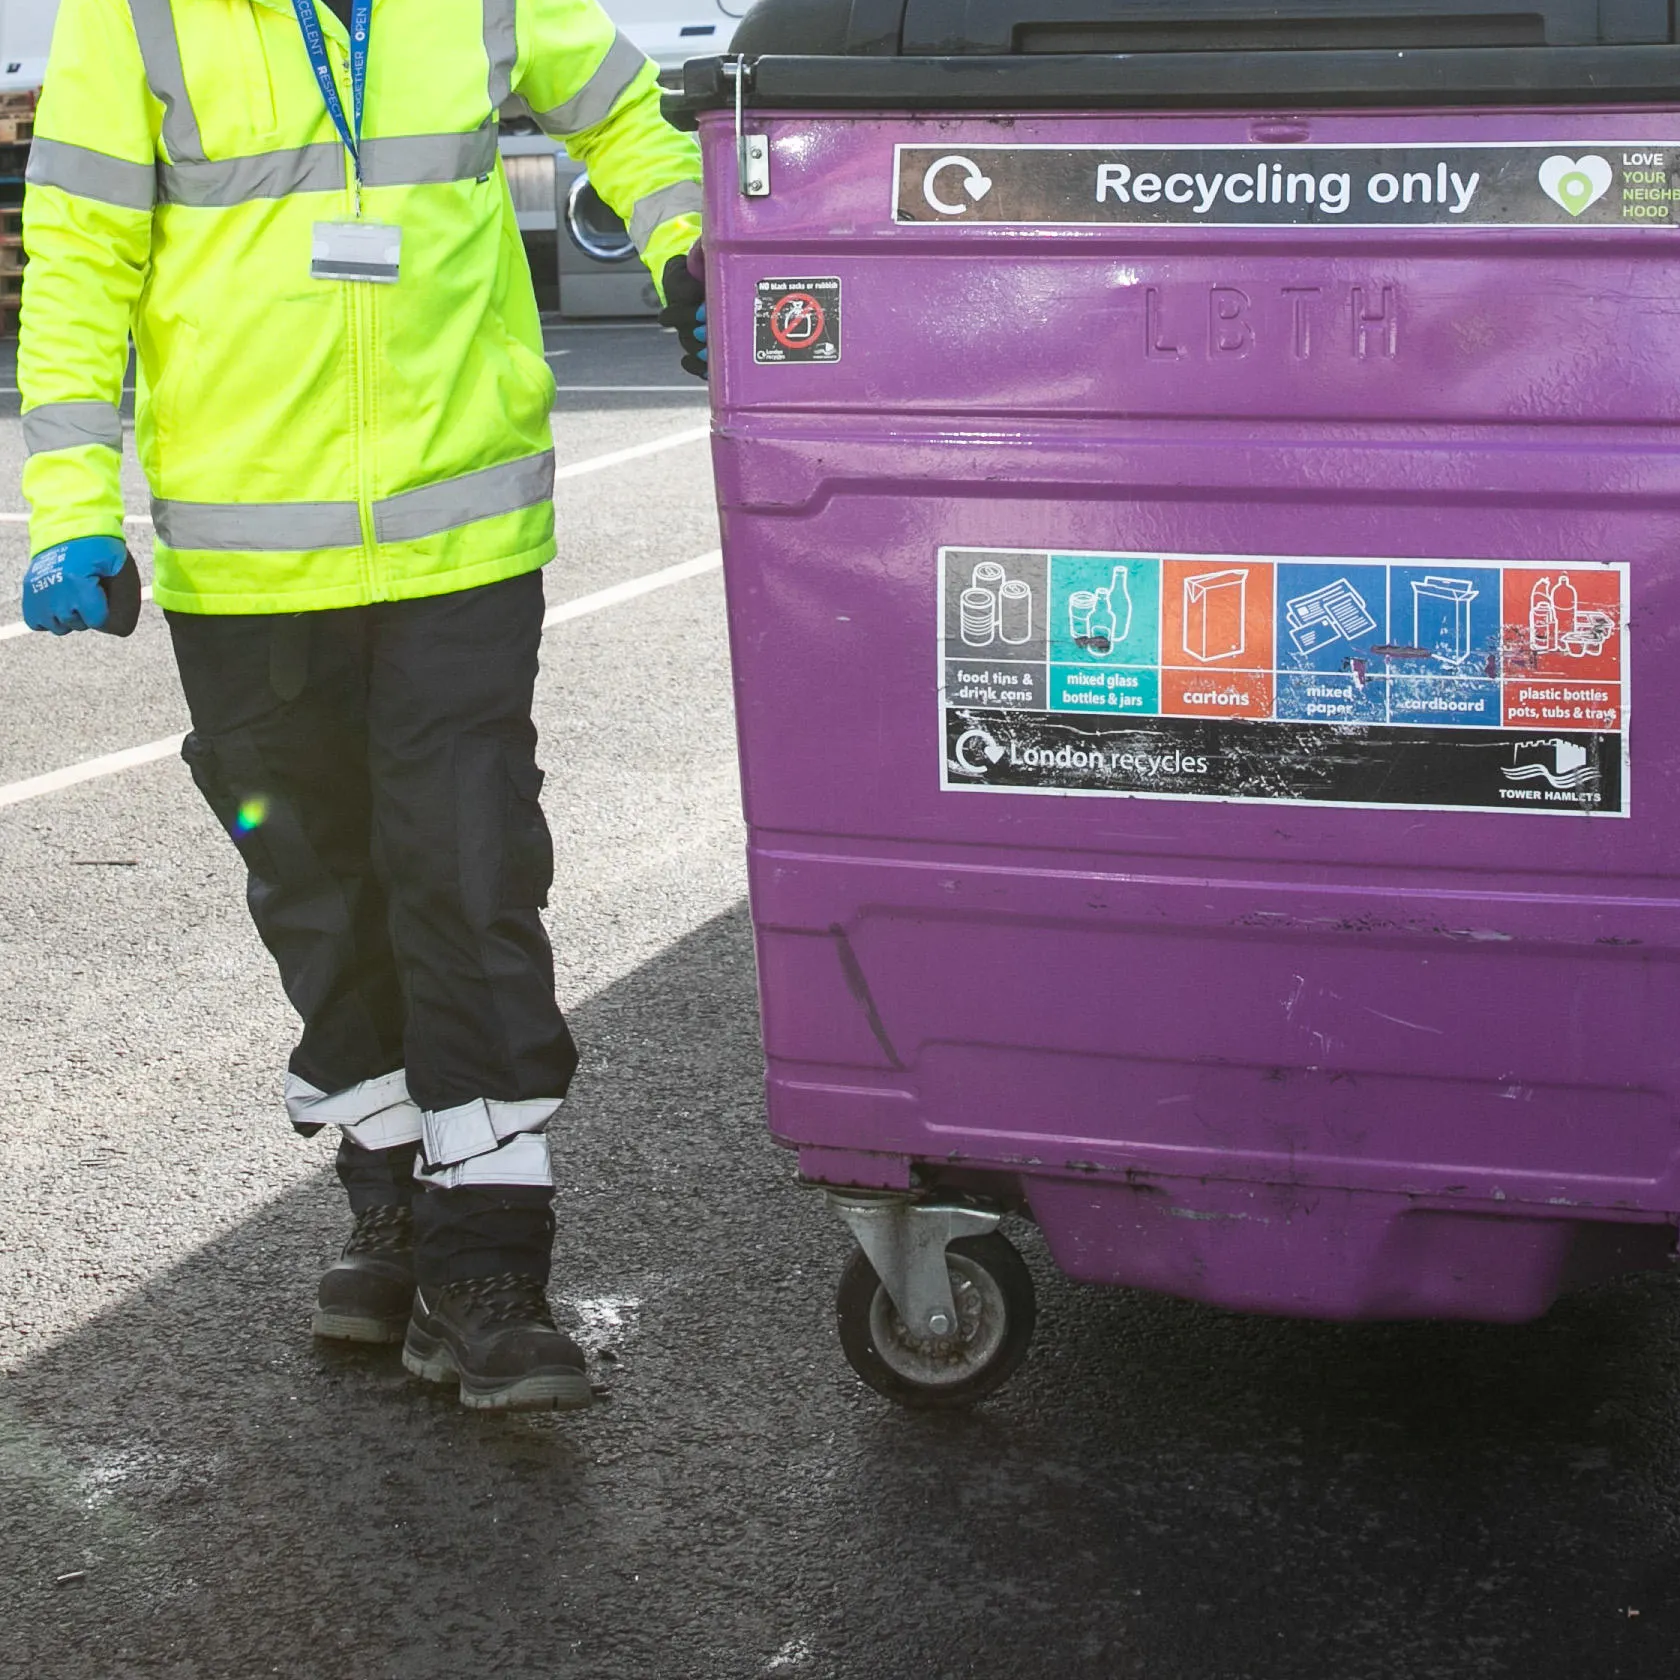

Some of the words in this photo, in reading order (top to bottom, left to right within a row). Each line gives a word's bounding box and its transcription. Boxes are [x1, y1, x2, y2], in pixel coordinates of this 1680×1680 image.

[355, 7, 368, 42] OPEN
[317, 65, 343, 119] RESPECT
[354, 51, 364, 118] TOGETHER
[1623, 153, 1664, 166] LOVE
[1623, 171, 1667, 184] YOUR
[1095, 163, 1352, 213] Recycling
[1367, 162, 1480, 213] only
[1623, 205, 1669, 217] HOOD
[759, 282, 770, 290] NO
[1145, 286, 1398, 360] LBTH
[957, 670, 988, 684] food
[993, 671, 1018, 685] tins
[1022, 673, 1033, 685] &
[1067, 672, 1104, 686] mixed
[1107, 674, 1138, 688] glass
[959, 686, 997, 700] drink
[1000, 690, 1033, 702] cans
[1183, 690, 1250, 706] cartons
[1306, 684, 1352, 698] mixed
[1519, 687, 1562, 702] plastic
[1564, 687, 1608, 702] bottles
[1063, 691, 1105, 704] bottles
[1108, 692, 1118, 704] &
[1119, 693, 1143, 708] jars
[1404, 697, 1485, 712] cardboard
[1307, 702, 1353, 716] paper
[1508, 706, 1539, 720] pots,
[1542, 706, 1570, 719] tubs
[1572, 707, 1583, 719] &
[1010, 741, 1104, 769] London
[1111, 749, 1208, 776] recycles
[1499, 789, 1541, 800] TOWER
[1544, 791, 1602, 802] HAMLETS
